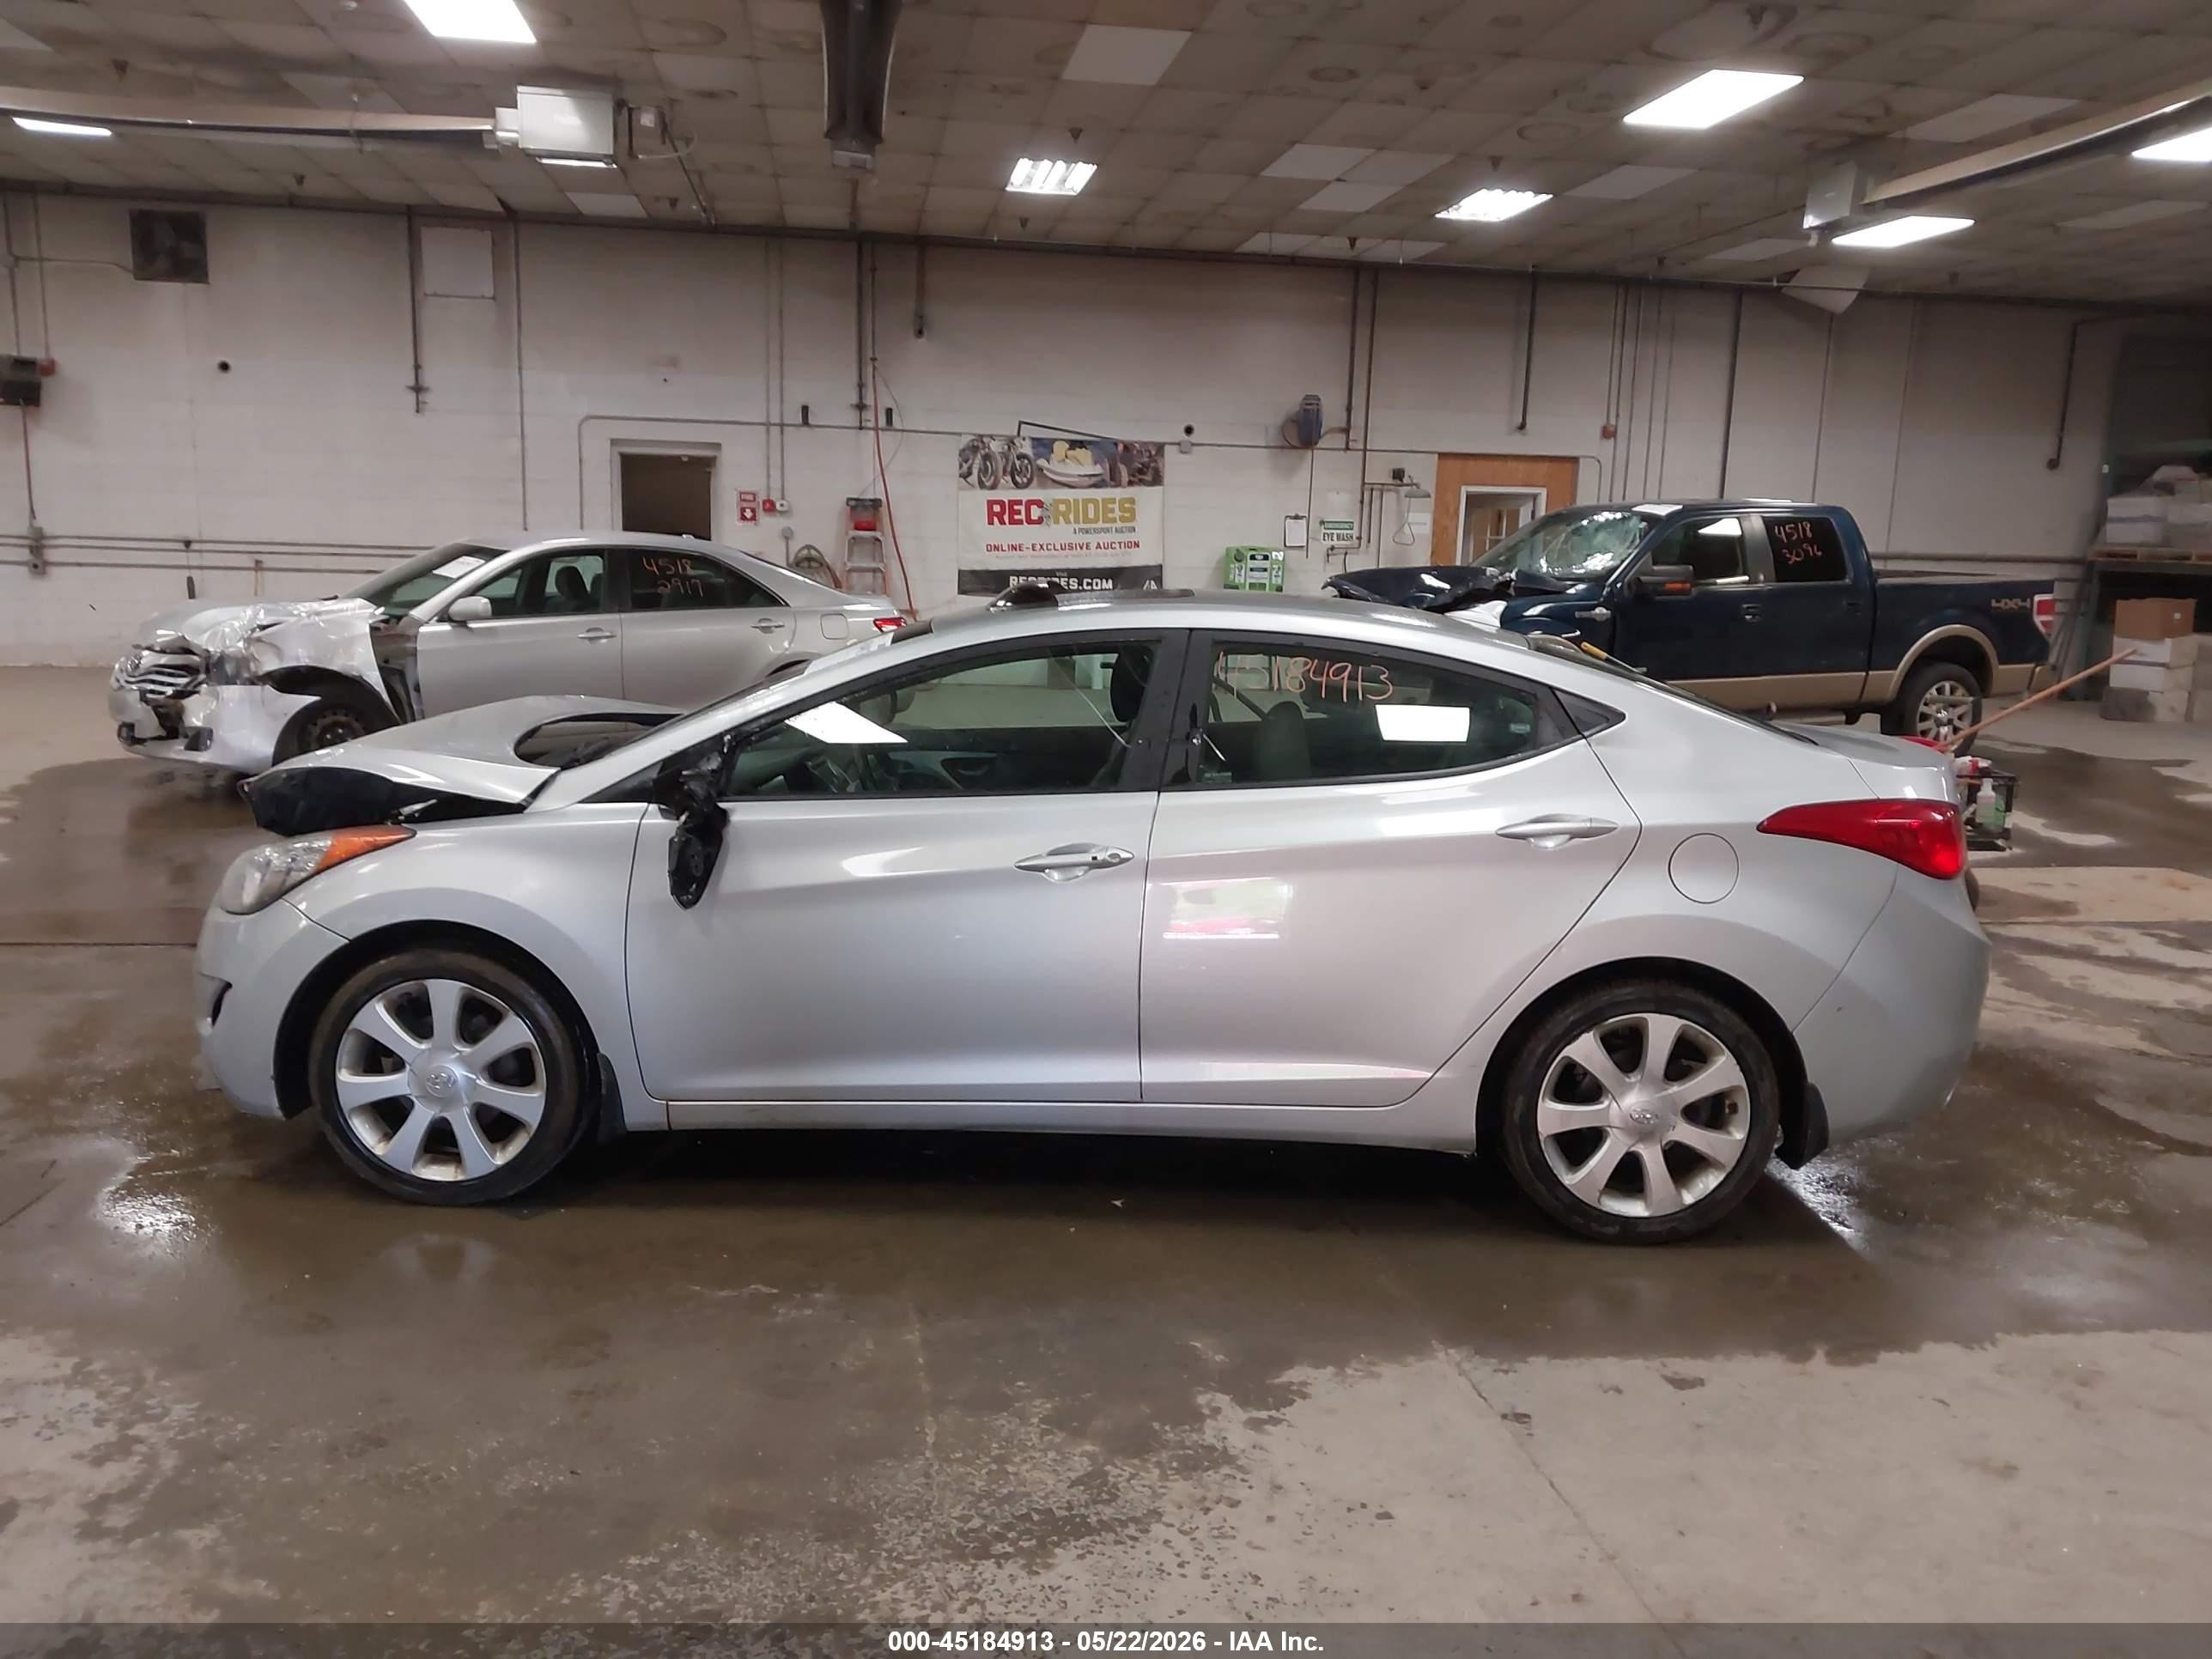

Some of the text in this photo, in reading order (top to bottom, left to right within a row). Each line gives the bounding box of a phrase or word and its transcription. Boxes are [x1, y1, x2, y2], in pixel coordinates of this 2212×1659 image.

[987, 497, 1136, 526] REC RIDES
[1073, 526, 1077, 535] A
[1774, 521, 1813, 544] 4518
[986, 540, 1140, 553] ONLINE-EXCLUSIVE AUCTION
[643, 556, 693, 576] 4518
[657, 578, 704, 598] 2917
